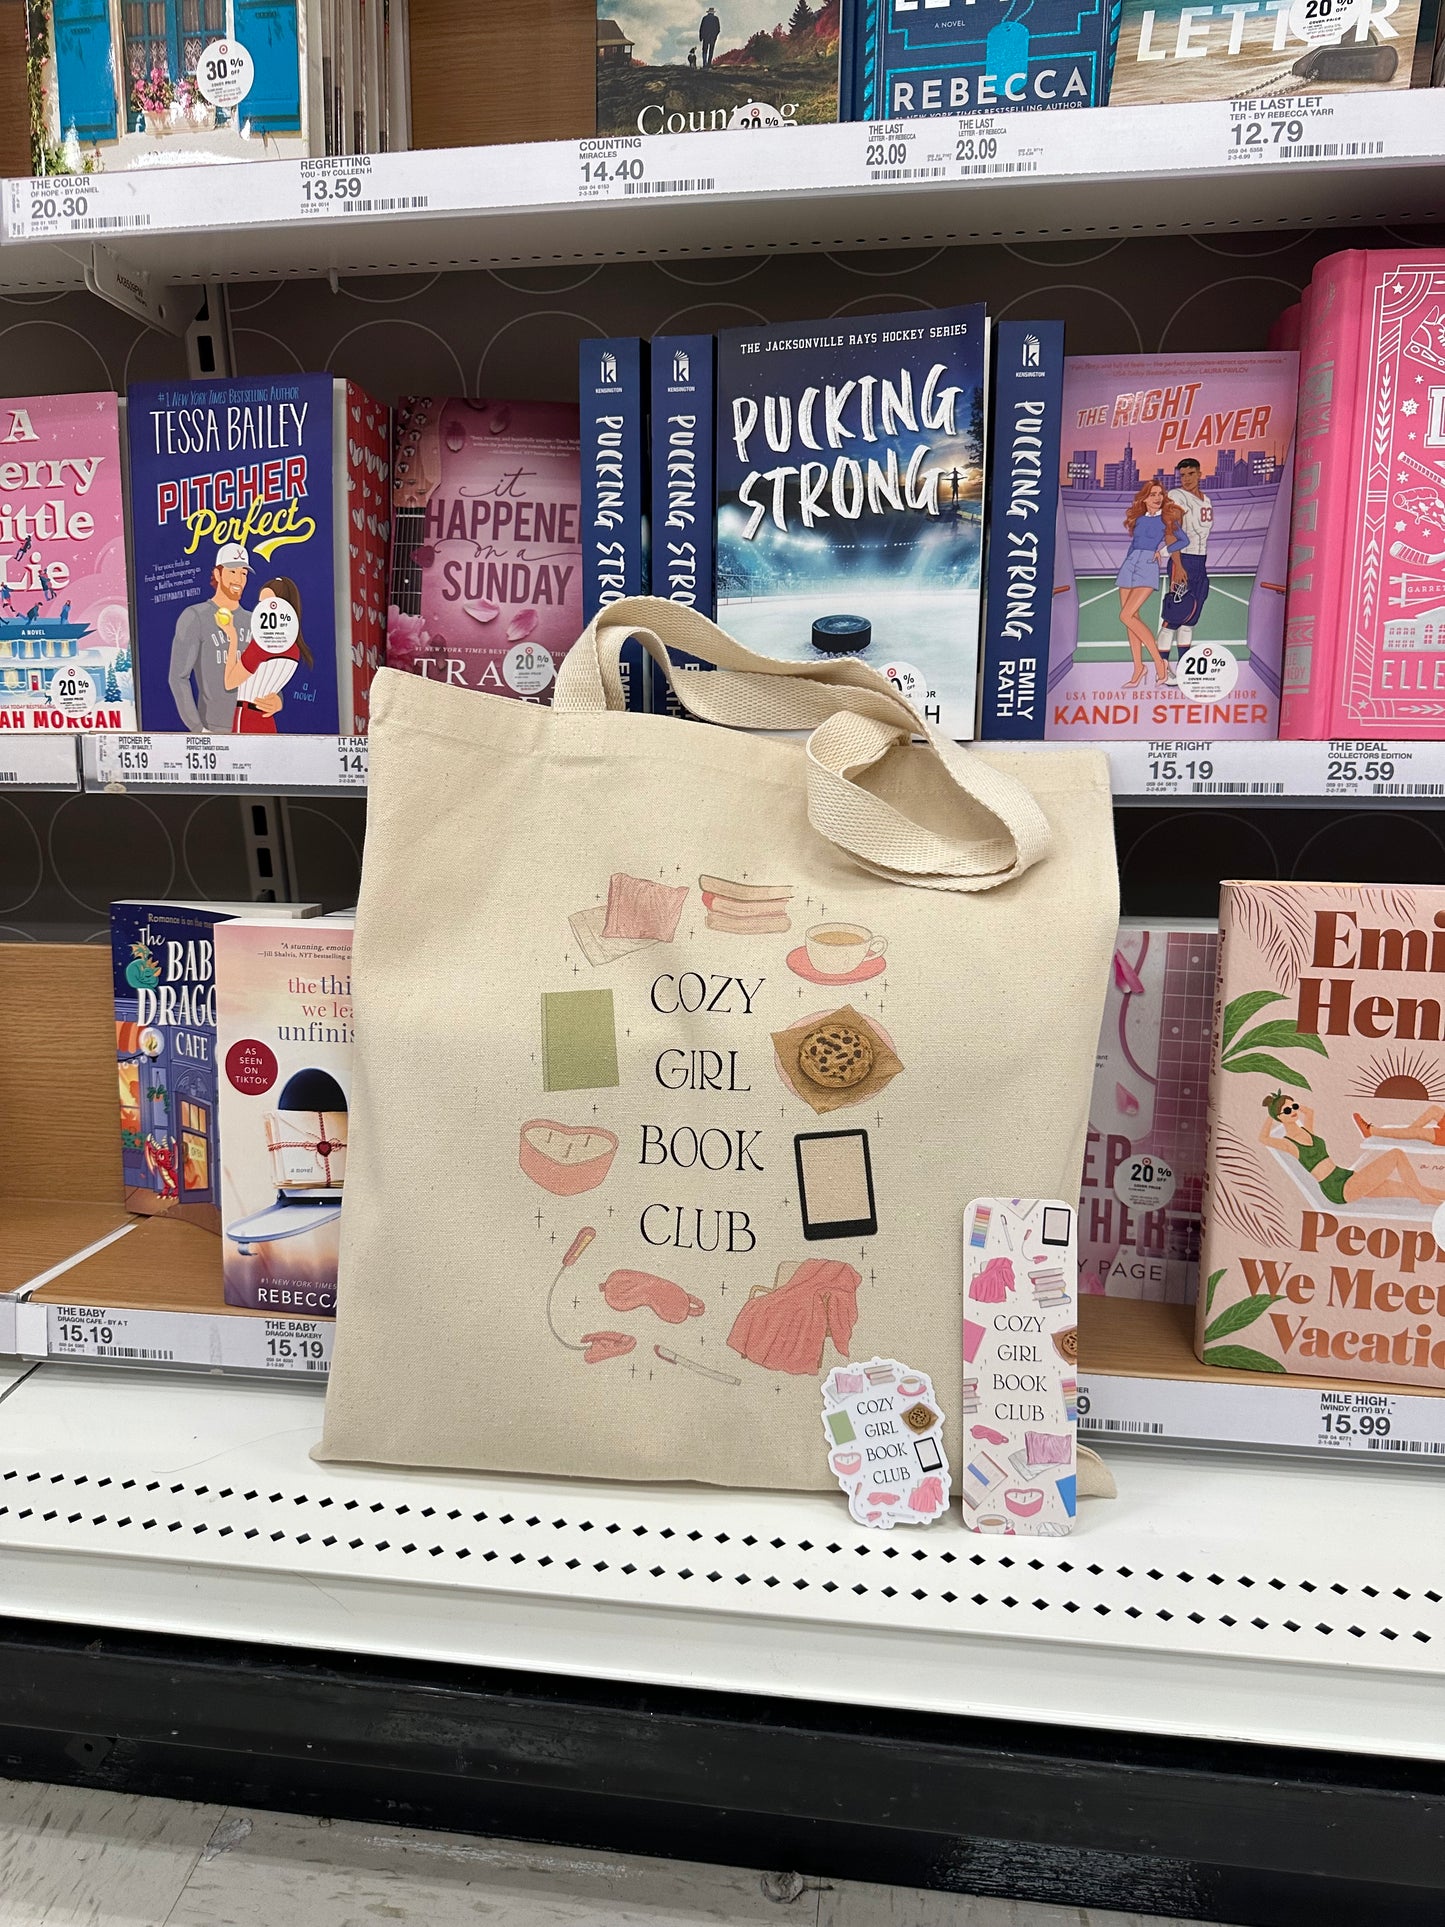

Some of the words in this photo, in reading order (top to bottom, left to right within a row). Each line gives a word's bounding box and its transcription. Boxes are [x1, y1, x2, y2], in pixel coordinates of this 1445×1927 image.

[941, 20, 966, 28] NOVEL
[1137, 0, 1401, 62] LETTR
[893, 66, 1087, 112] REBECCA
[984, 105, 1043, 115] BESTSELLING
[1045, 101, 1083, 111] AUTHOR
[1230, 101, 1257, 112] THE
[1260, 98, 1294, 110] LAST
[1297, 97, 1323, 108] LET
[637, 98, 799, 135] Coung
[959, 119, 974, 129] THE
[976, 118, 995, 129] LAST
[1230, 113, 1247, 121] TER
[1267, 109, 1309, 118] REBECCA
[1310, 108, 1334, 117] YARR
[869, 125, 884, 135] THE
[885, 124, 904, 134] LAST
[895, 133, 916, 141] REBECCA
[985, 128, 1007, 136] REBECCA
[1231, 120, 1304, 146] 12.79
[579, 138, 642, 151] COUNTING
[866, 143, 907, 165] 23.09
[955, 138, 998, 160] 23.09
[300, 157, 371, 170] REGRETTING
[579, 151, 618, 159] MIRACLES
[300, 170, 315, 178] YOU
[332, 168, 366, 177] COLLEEN
[580, 159, 644, 183] 14.40
[30, 180, 51, 190] THE
[53, 177, 90, 188] COLOR
[75, 187, 99, 195] DANIEL
[302, 177, 362, 200] 13.59
[31, 197, 88, 219] 20.30
[740, 344, 761, 354] THE
[765, 336, 844, 352] JACKSONVILLE
[849, 333, 877, 345] RAYS
[882, 328, 925, 343] HOCKEY
[929, 324, 967, 338] SERIES
[172, 391, 189, 406] NEW
[190, 389, 208, 405] YORK
[209, 390, 227, 405] TIMES
[228, 388, 269, 403] BESTSELLING
[270, 386, 300, 402] AUTHOR
[732, 363, 964, 463] PUCKING
[1077, 406, 1109, 428] THE
[1111, 383, 1203, 429] RIGHT
[1, 408, 40, 443] A
[149, 408, 220, 454] TESSA
[227, 402, 308, 451] BAILEY
[1156, 406, 1272, 455] PLAYER
[1006, 400, 1045, 521] PUCKING
[594, 414, 625, 532] PUCKING
[664, 414, 697, 531] PUCKING
[157, 454, 309, 525] PITCHER
[738, 444, 949, 541] STRONG
[184, 493, 316, 555] Perfect
[426, 498, 582, 545] HAPPENE
[0, 551, 71, 593] Lie
[442, 561, 574, 606] SUNDAY
[1000, 531, 1039, 642] STRONG
[293, 688, 317, 703] novel
[996, 660, 1014, 718] RATH
[1016, 658, 1036, 720] EMILY
[1065, 692, 1086, 701] USA
[1091, 691, 1126, 700] TODAY
[33, 710, 122, 729] MORGAN
[1053, 704, 1139, 725] KANDI
[1151, 704, 1269, 725] STEINER
[118, 737, 140, 746] PITCHER
[141, 736, 151, 744] PE
[186, 737, 212, 746] PITCHER
[1148, 742, 1173, 751] THE
[1175, 742, 1212, 751] RIGHT
[1328, 742, 1354, 751] THE
[1356, 742, 1388, 751] DEAL
[118, 752, 148, 769] 15.19
[185, 752, 217, 770] 15.19
[1148, 761, 1214, 780] 15.19
[1327, 761, 1395, 781] 25.59
[148, 913, 180, 924] Romance
[139, 924, 165, 947] The
[313, 953, 346, 961] bestselling
[289, 977, 316, 994] the
[650, 971, 766, 1014] COZY
[302, 1004, 327, 1018] we
[175, 1031, 208, 1061] CAFE
[245, 1047, 257, 1055] AS
[239, 1056, 263, 1065] SEEN
[244, 1066, 258, 1074] ON
[655, 1048, 752, 1092] GIRL
[235, 1076, 268, 1085] TIKTOK
[638, 1124, 765, 1171] BOOK
[639, 1203, 757, 1253] CLUB
[1098, 1259, 1163, 1281] PAGE
[314, 1281, 337, 1289] TIMES
[1238, 1257, 1316, 1304] We
[57, 1307, 76, 1316] THE
[78, 1309, 106, 1318] BABY
[265, 1320, 286, 1330] THE
[288, 1321, 317, 1331] BABY
[993, 1314, 1046, 1333] COZY
[59, 1324, 113, 1343] 15.19
[265, 1330, 294, 1338] DRAGON
[267, 1338, 324, 1358] 15.19
[997, 1344, 1043, 1363] GIRL
[992, 1373, 1048, 1393] BOOK
[856, 1396, 895, 1416] COZY
[1320, 1403, 1350, 1413] (WINDY
[1351, 1405, 1373, 1414] CITY)
[1321, 1393, 1352, 1404] MILE
[1355, 1395, 1388, 1406] HIGH
[994, 1403, 1046, 1422] CLUB
[864, 1420, 900, 1438] GIRL
[1321, 1414, 1391, 1436] 15.99
[865, 1442, 909, 1462] BOOK
[872, 1466, 911, 1485] CLUB
